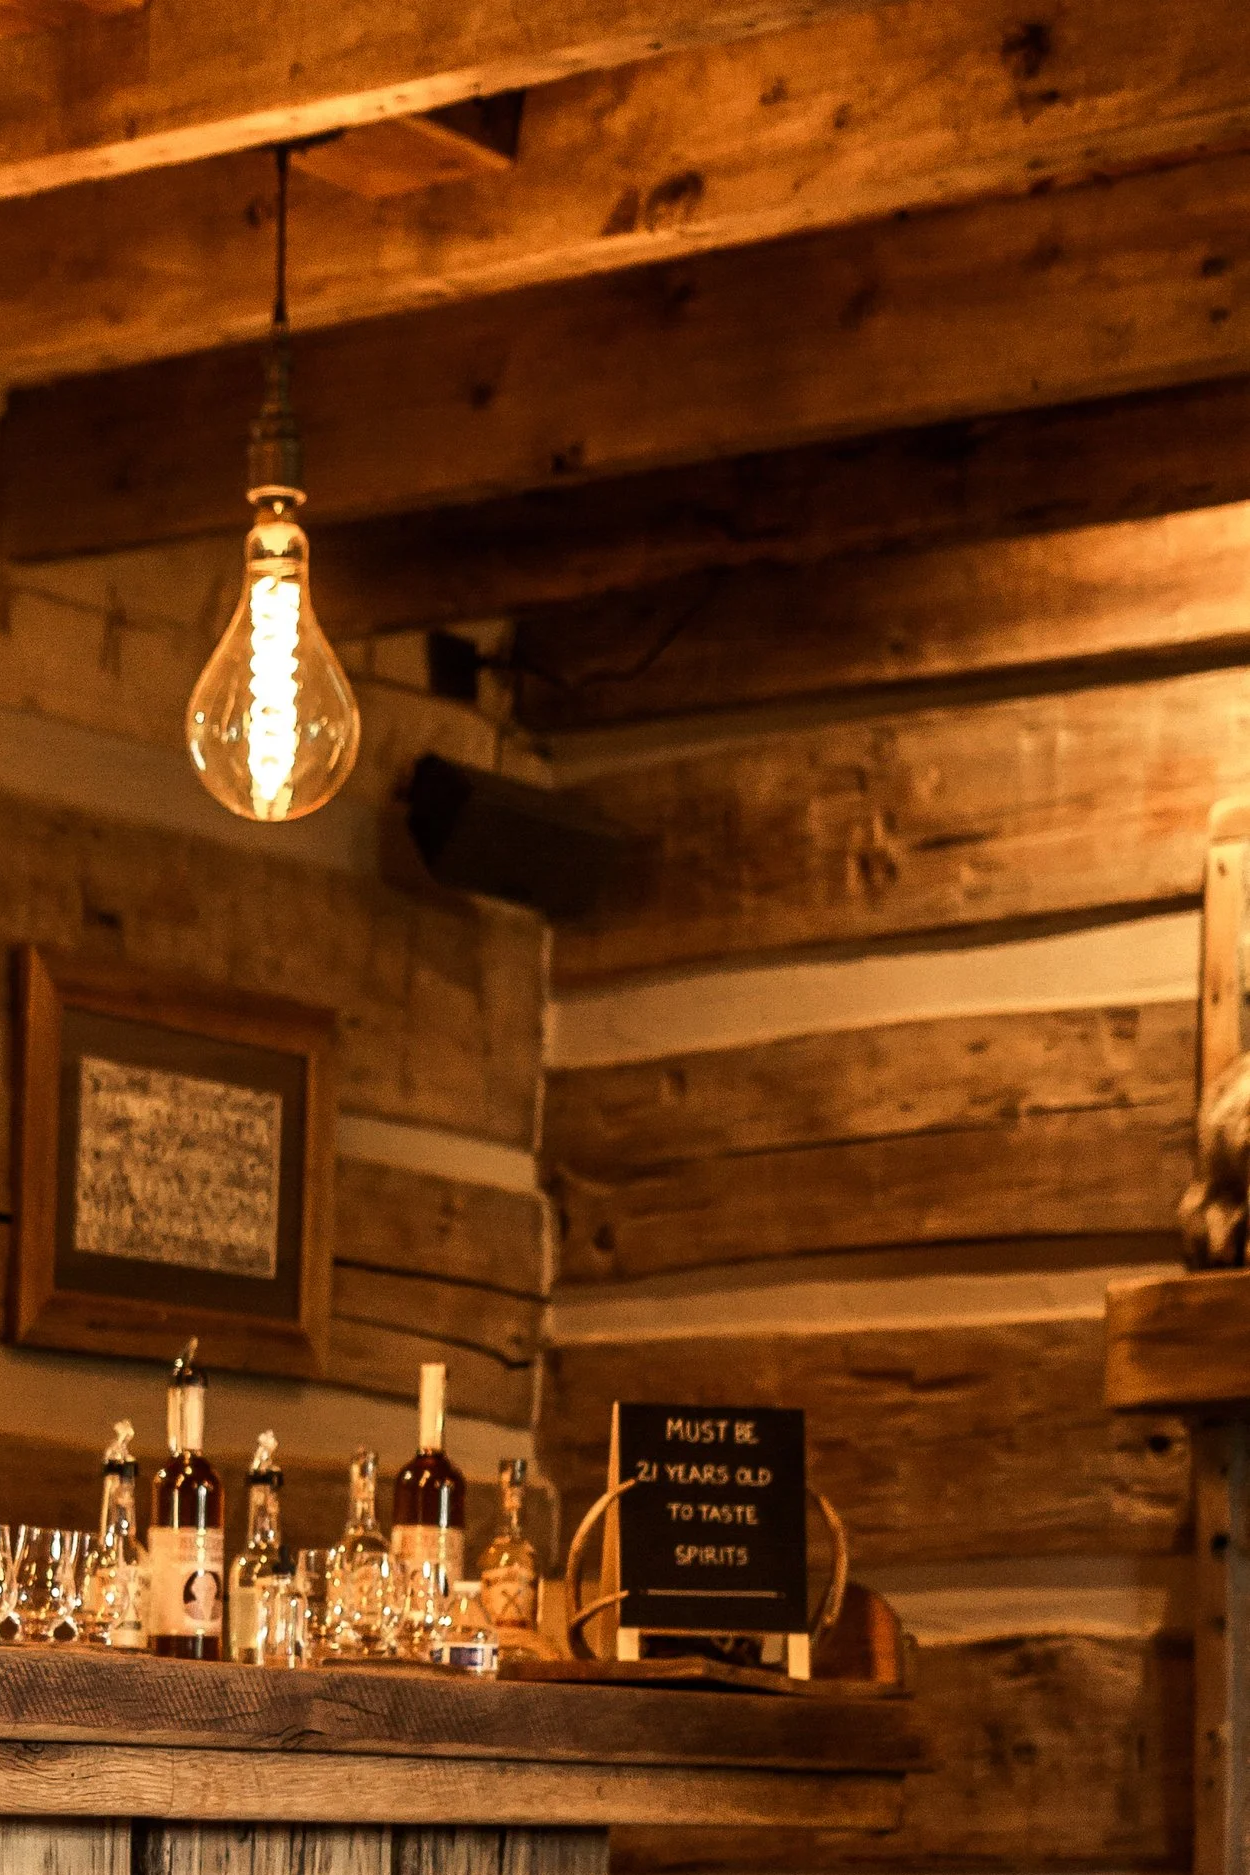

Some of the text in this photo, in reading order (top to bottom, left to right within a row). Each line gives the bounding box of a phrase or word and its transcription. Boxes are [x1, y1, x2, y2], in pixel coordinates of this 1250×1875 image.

[666, 1418, 759, 1444] MUST BE
[635, 1460, 772, 1487] 21 YEARS OLD
[668, 1503, 758, 1525] TO TASTE
[675, 1545, 749, 1566] SPIRITS
